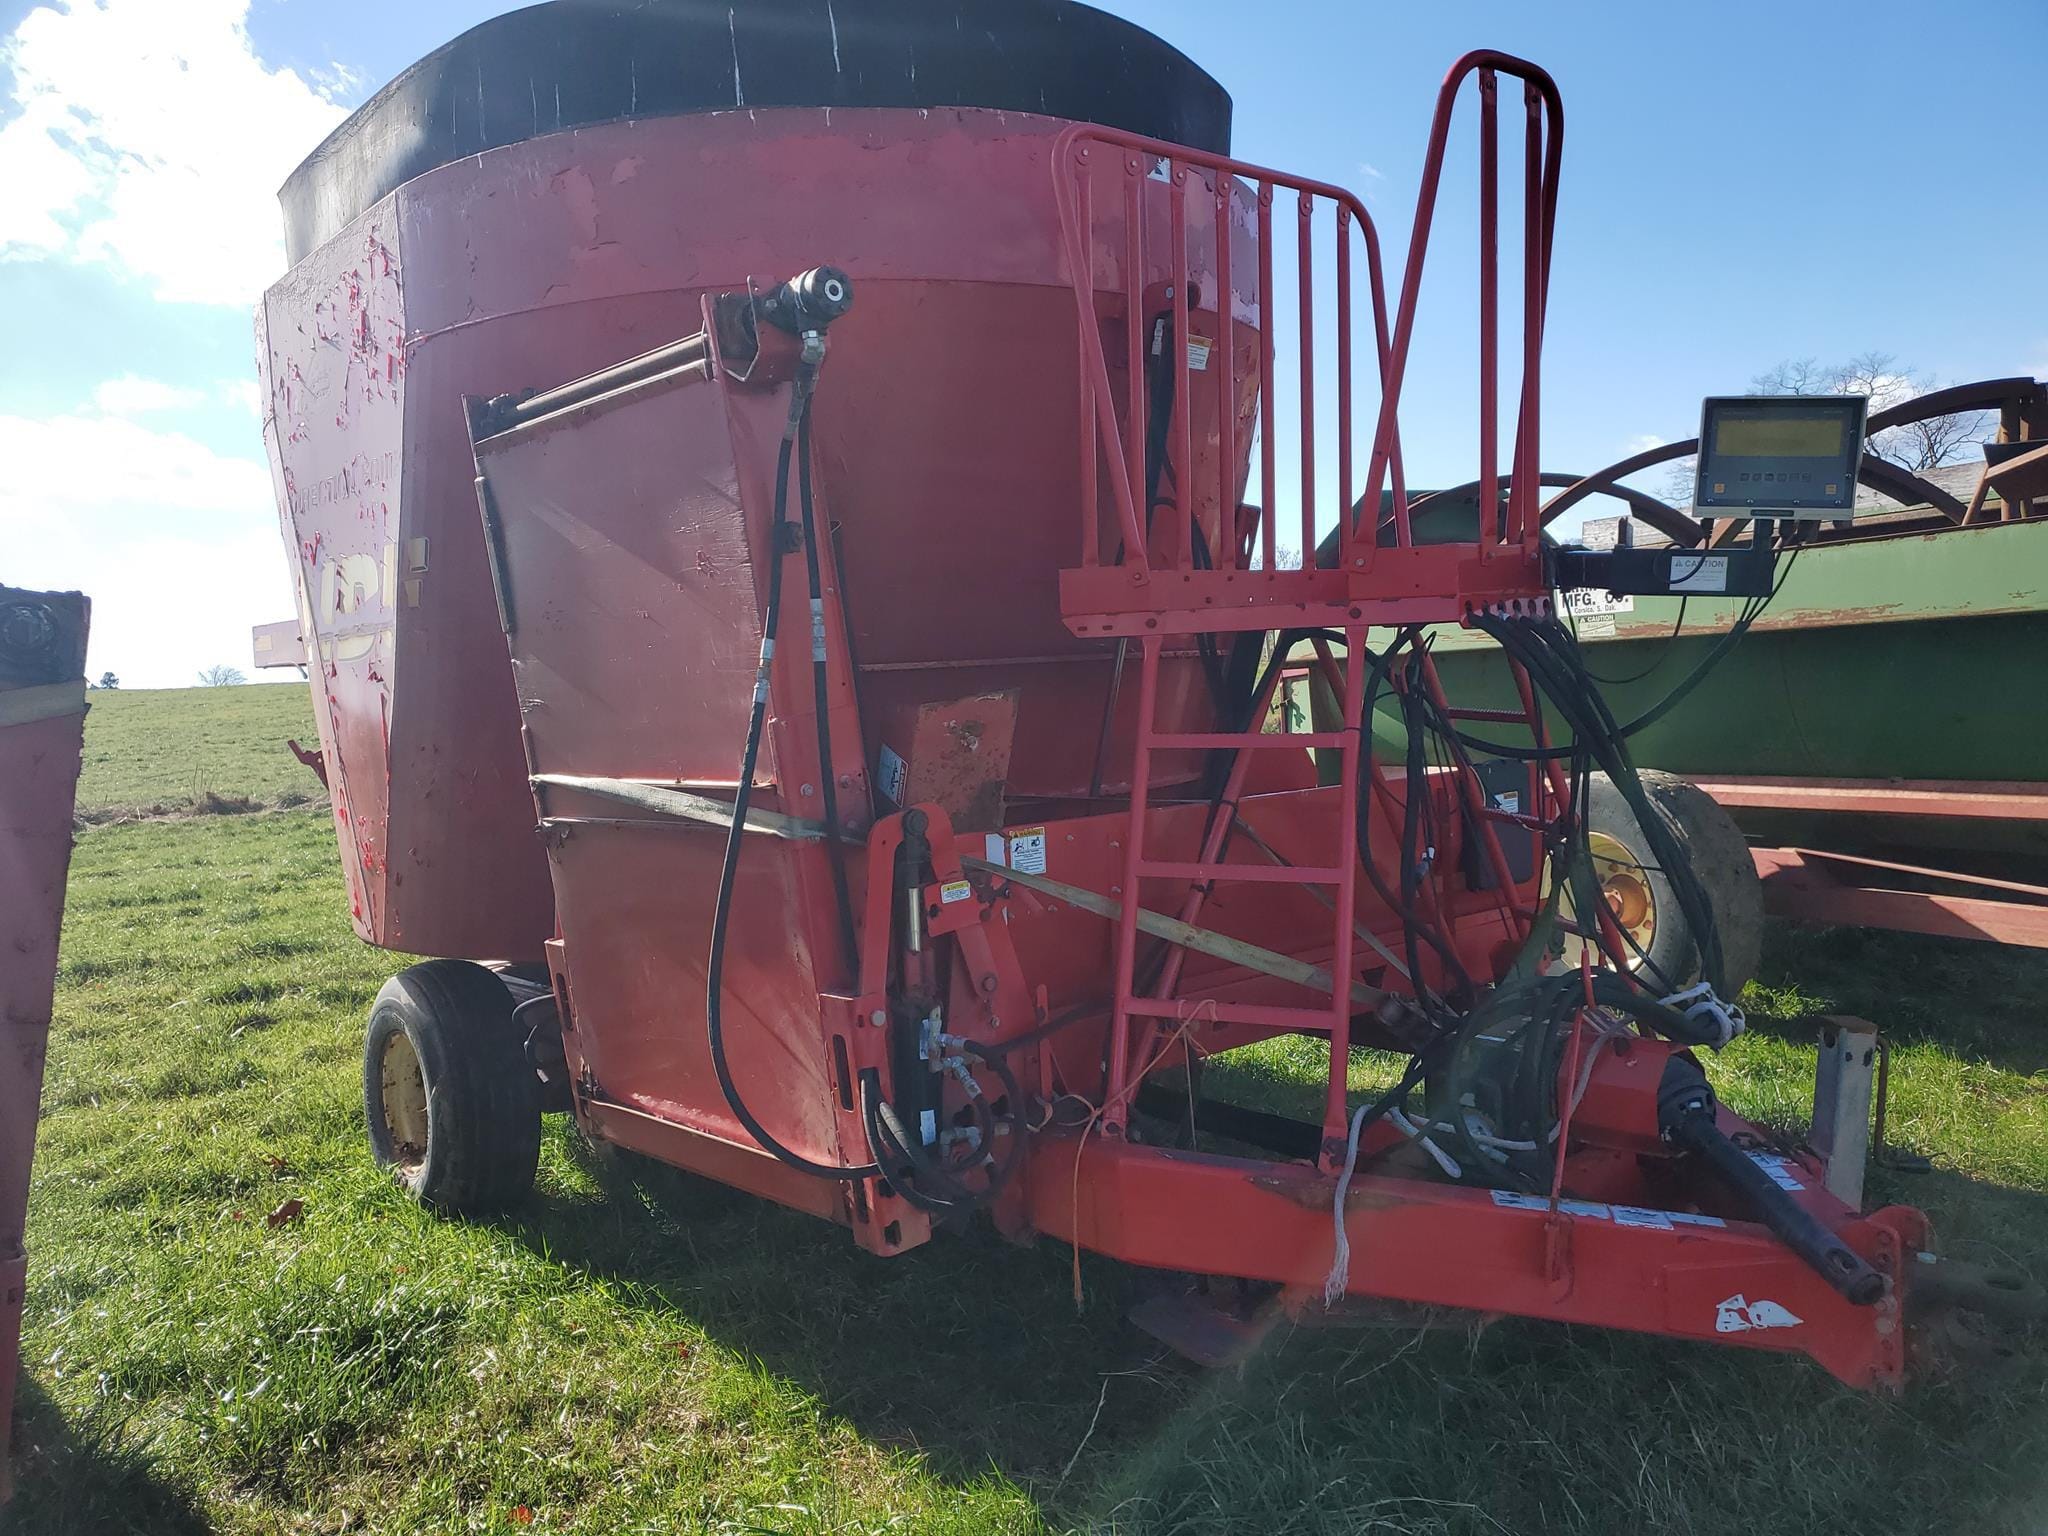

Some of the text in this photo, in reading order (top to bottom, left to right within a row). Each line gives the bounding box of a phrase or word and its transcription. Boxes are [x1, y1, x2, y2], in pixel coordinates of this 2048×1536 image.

[1685, 560, 1724, 568] CATION
[1561, 591, 1596, 607] MFG.
[1587, 614, 1614, 622] CAUTION
